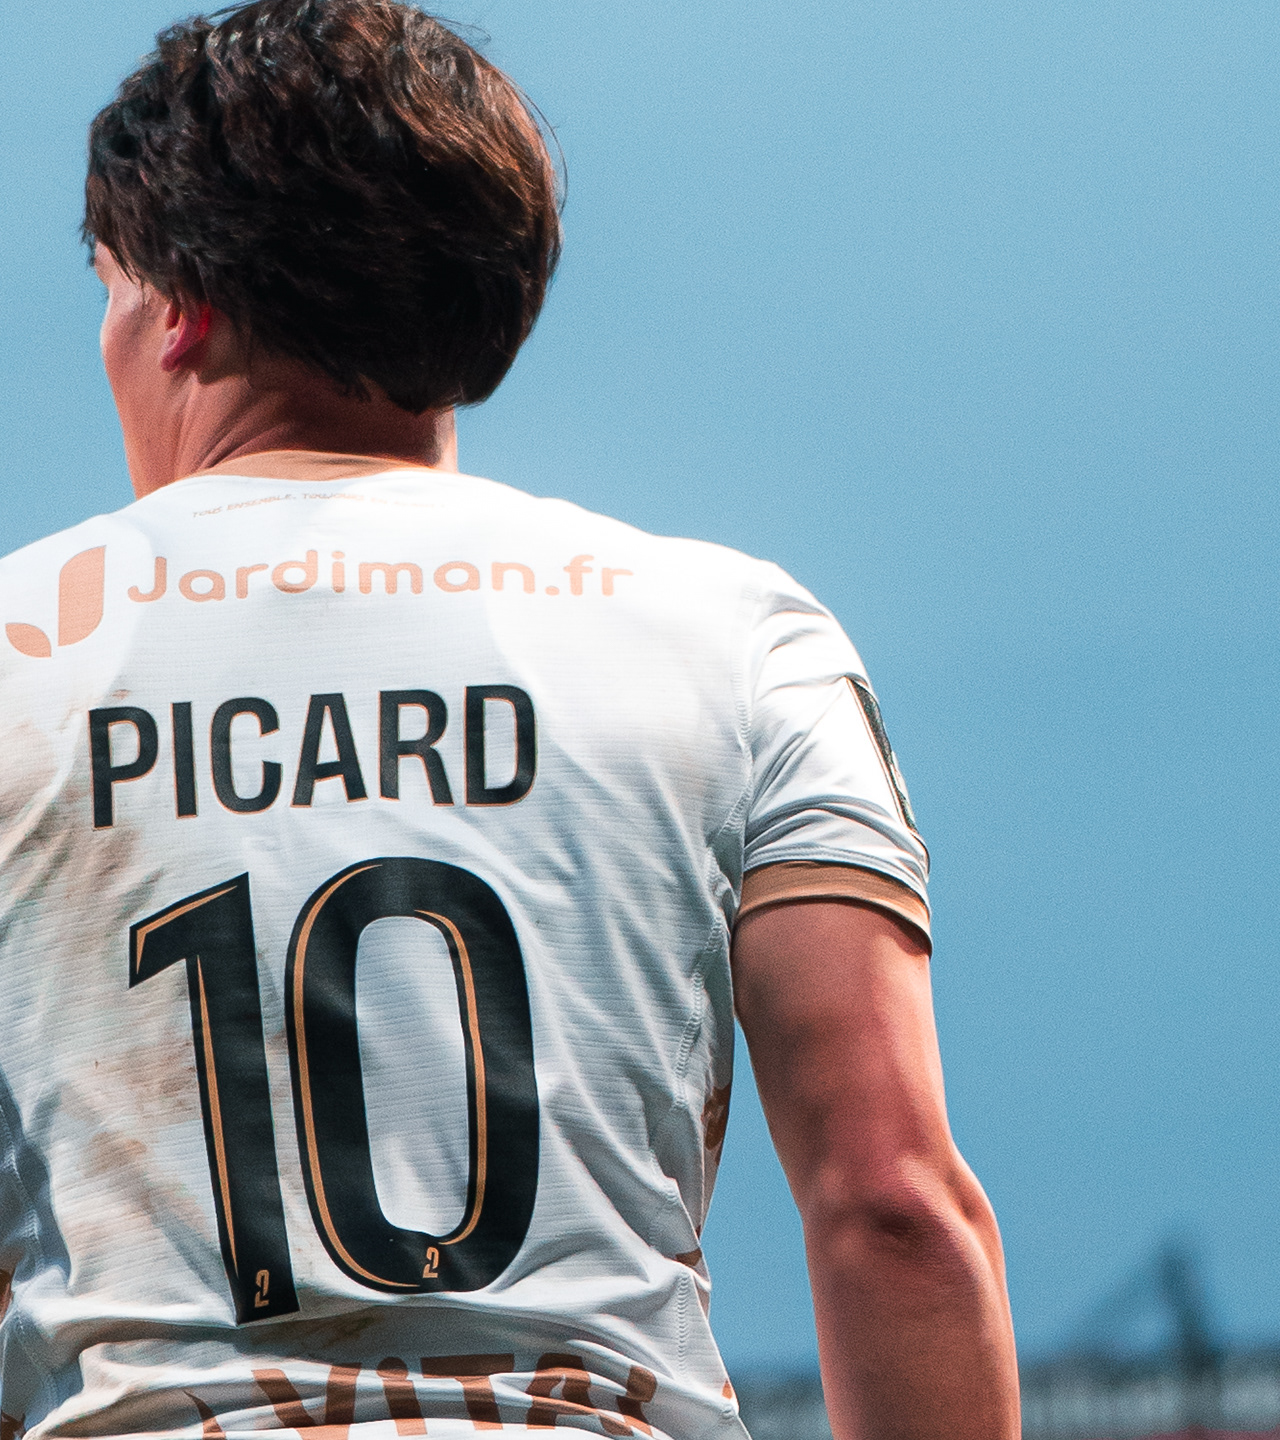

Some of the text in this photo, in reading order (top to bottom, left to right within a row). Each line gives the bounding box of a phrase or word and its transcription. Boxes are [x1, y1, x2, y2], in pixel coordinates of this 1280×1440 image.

[127, 549, 635, 603] Jardiman.fr
[87, 684, 538, 830] PICARD
[127, 856, 541, 1326] 10
